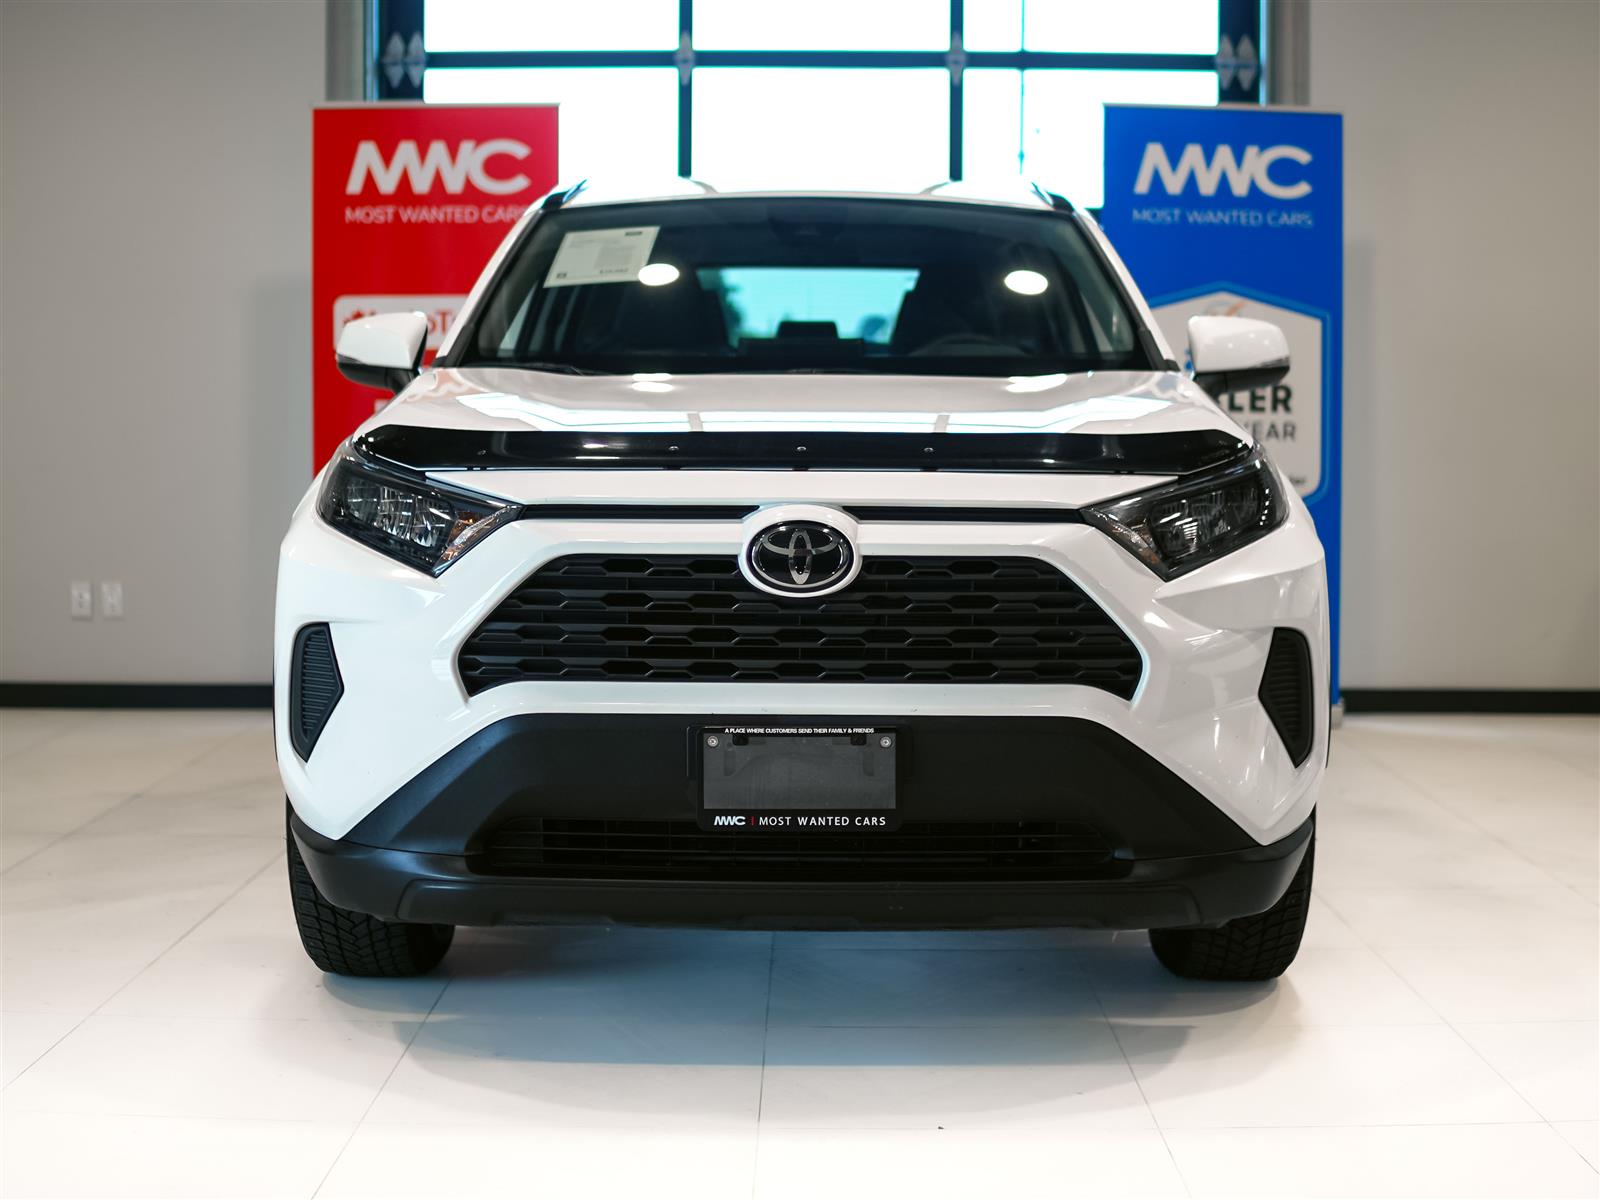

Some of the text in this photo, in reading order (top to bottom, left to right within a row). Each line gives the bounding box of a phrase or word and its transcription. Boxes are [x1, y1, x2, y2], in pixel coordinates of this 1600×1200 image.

[346, 139, 532, 196] MWC
[1133, 141, 1314, 200] MWC
[345, 205, 396, 224] MOST
[399, 205, 479, 224] WANTED
[1132, 208, 1314, 228] MOST WANTED CARS
[1227, 384, 1293, 413] LER
[713, 815, 887, 826] MWC MOST WANTED CARS
